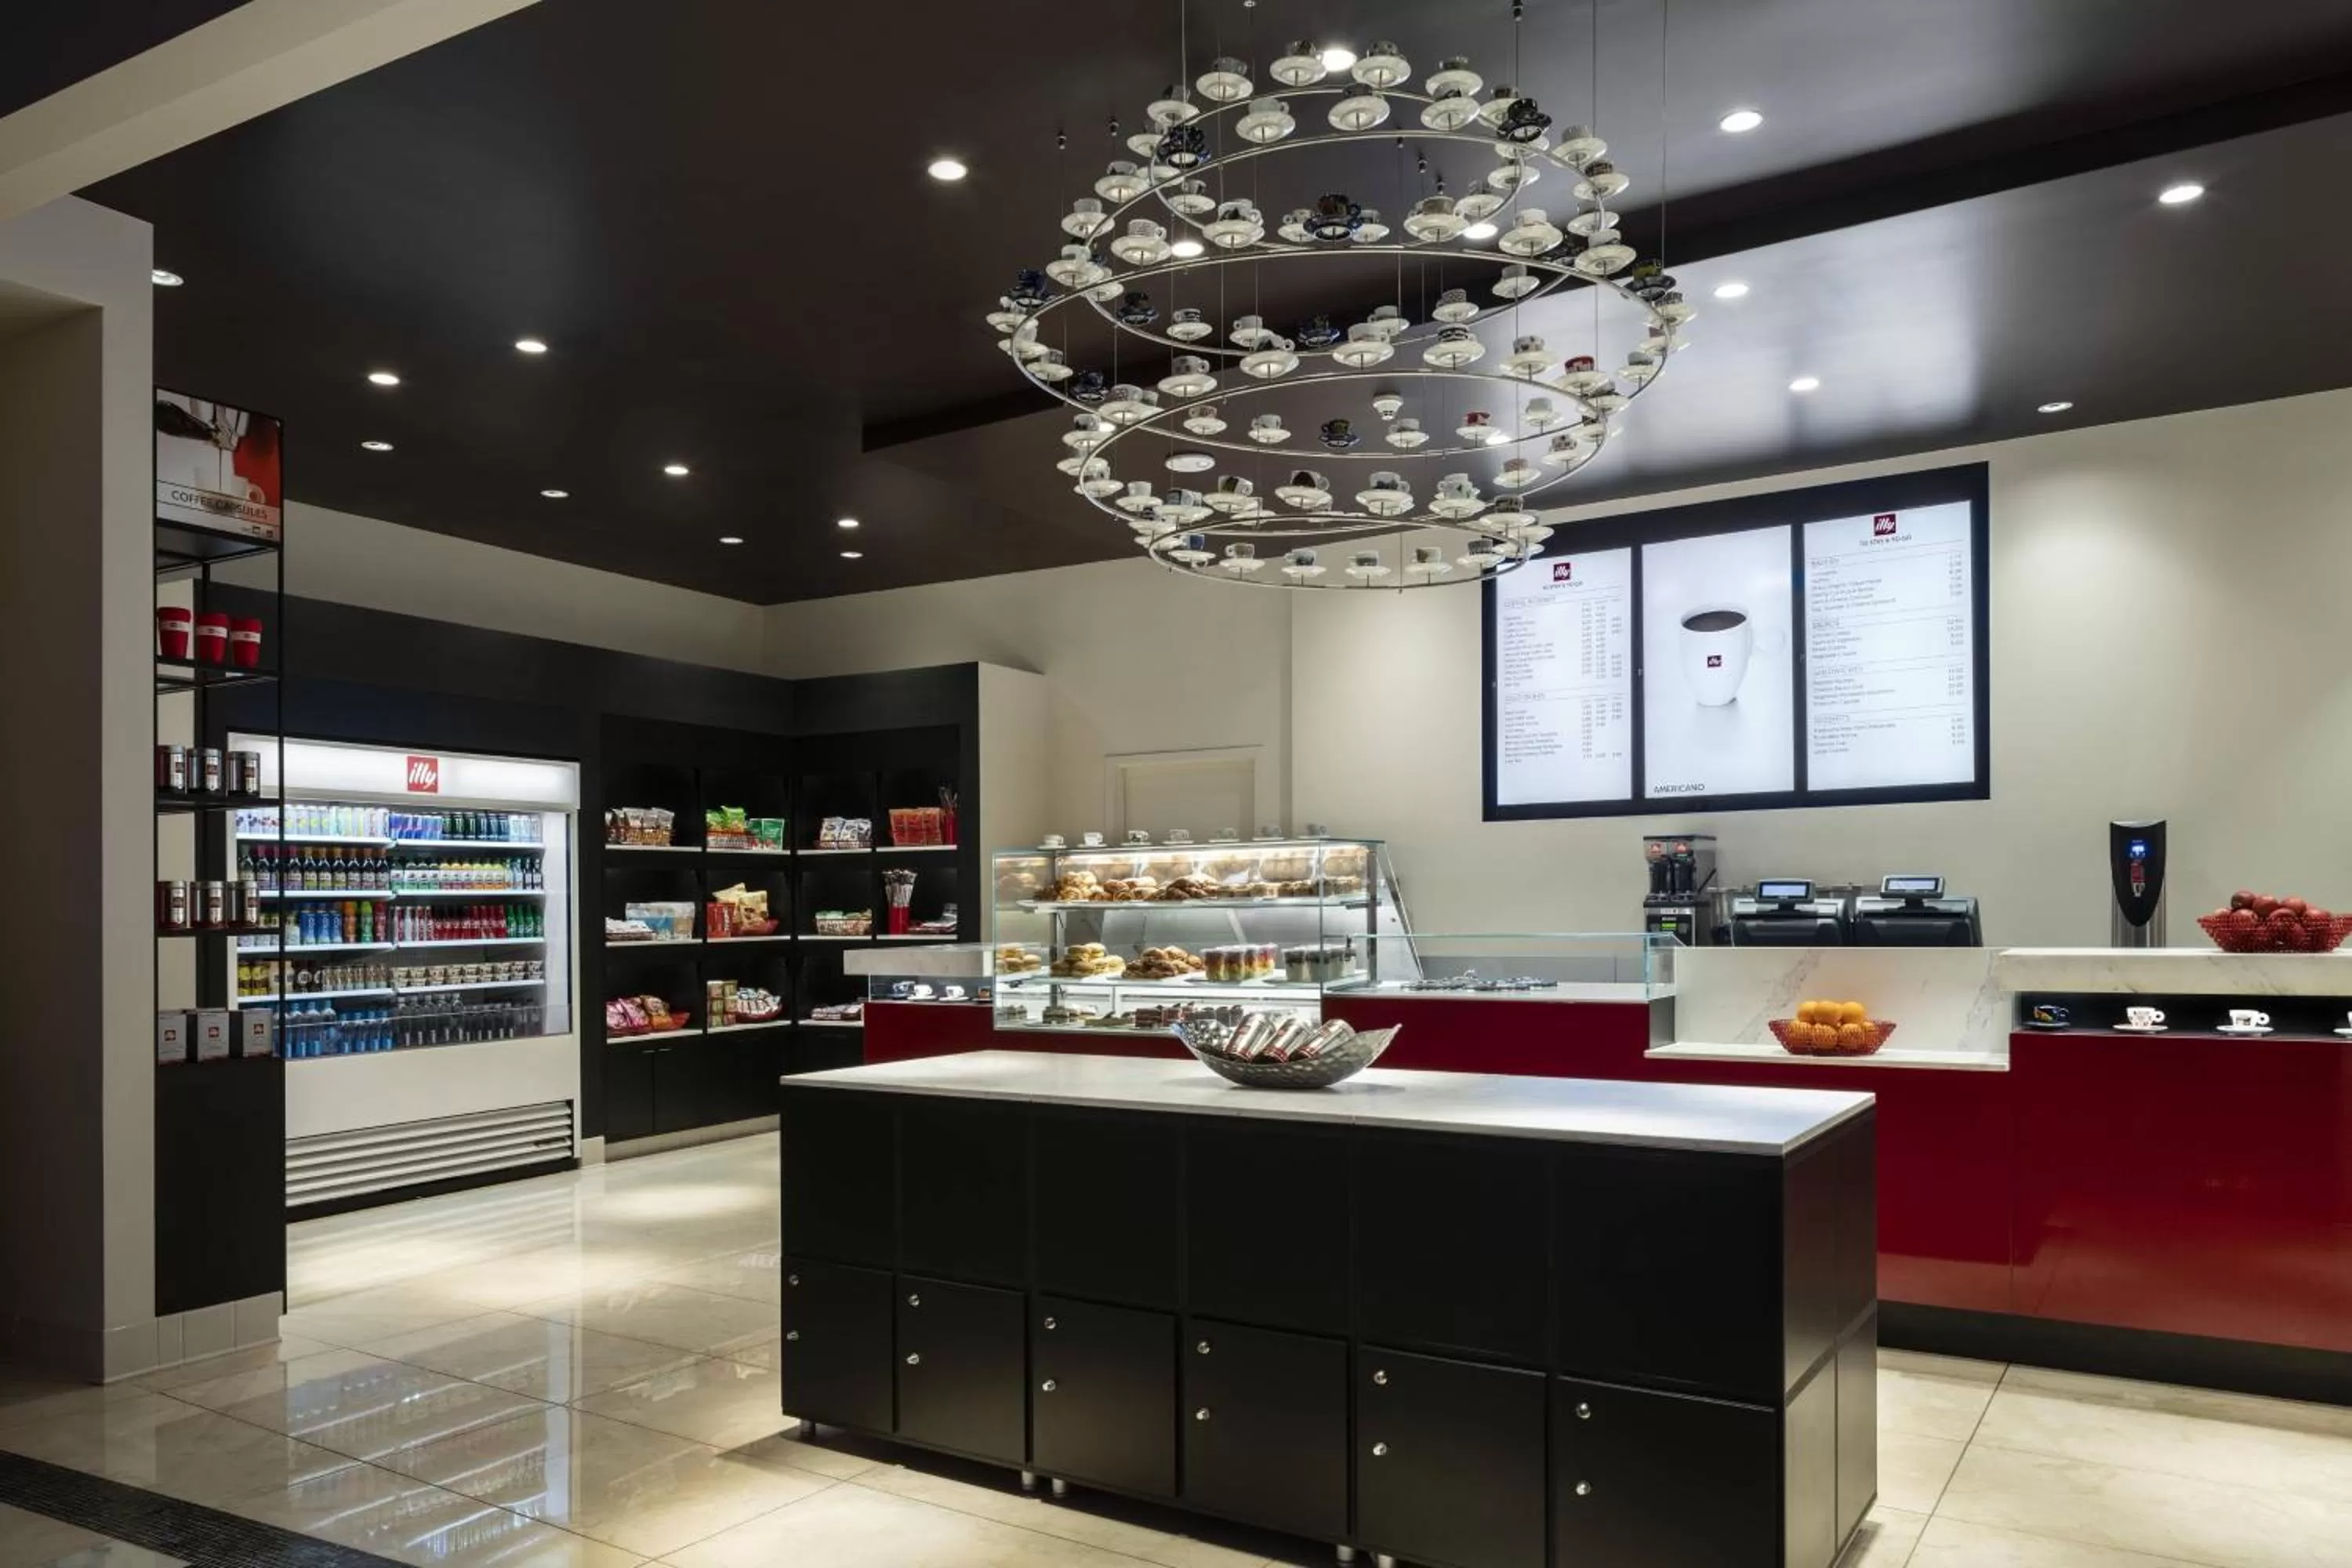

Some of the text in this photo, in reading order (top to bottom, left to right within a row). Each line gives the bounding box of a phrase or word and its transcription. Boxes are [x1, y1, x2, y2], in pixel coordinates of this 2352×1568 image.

[171, 489, 214, 506] COFFEE
[1875, 516, 1895, 533] illy
[409, 761, 437, 789] illy
[1653, 783, 1706, 793] AMERICANO
